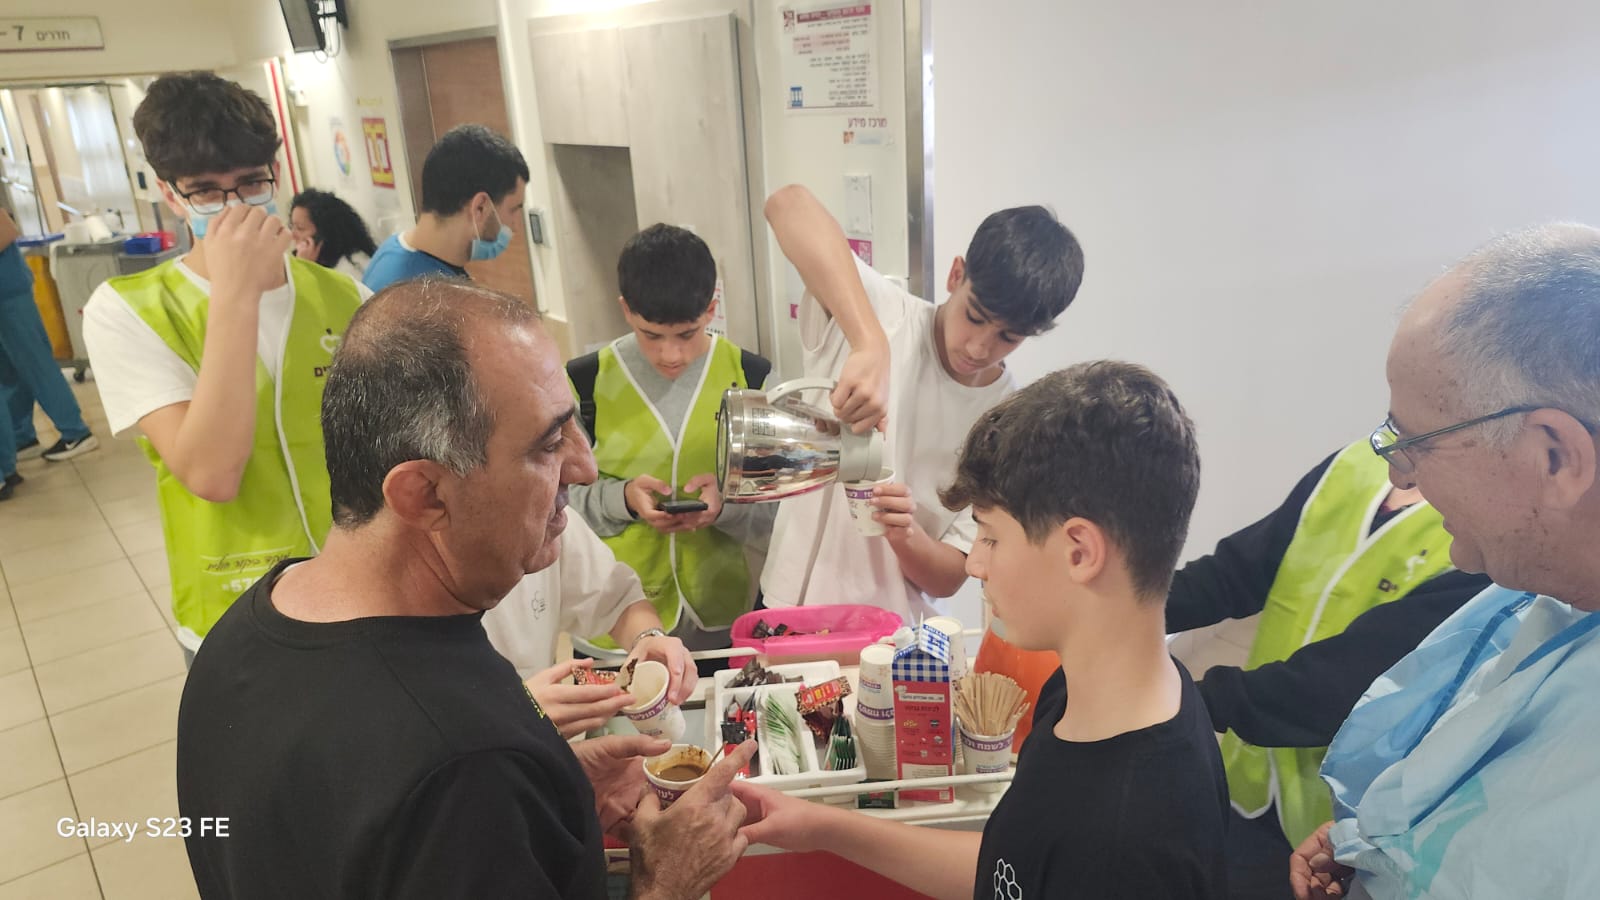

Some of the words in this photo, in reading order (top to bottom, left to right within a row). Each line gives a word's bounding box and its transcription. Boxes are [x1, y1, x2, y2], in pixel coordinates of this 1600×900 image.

[36, 30, 71, 41] חדרים
[848, 117, 866, 128] מידע
[868, 117, 888, 128] מרכז
[976, 741, 1004, 750] לשמח
